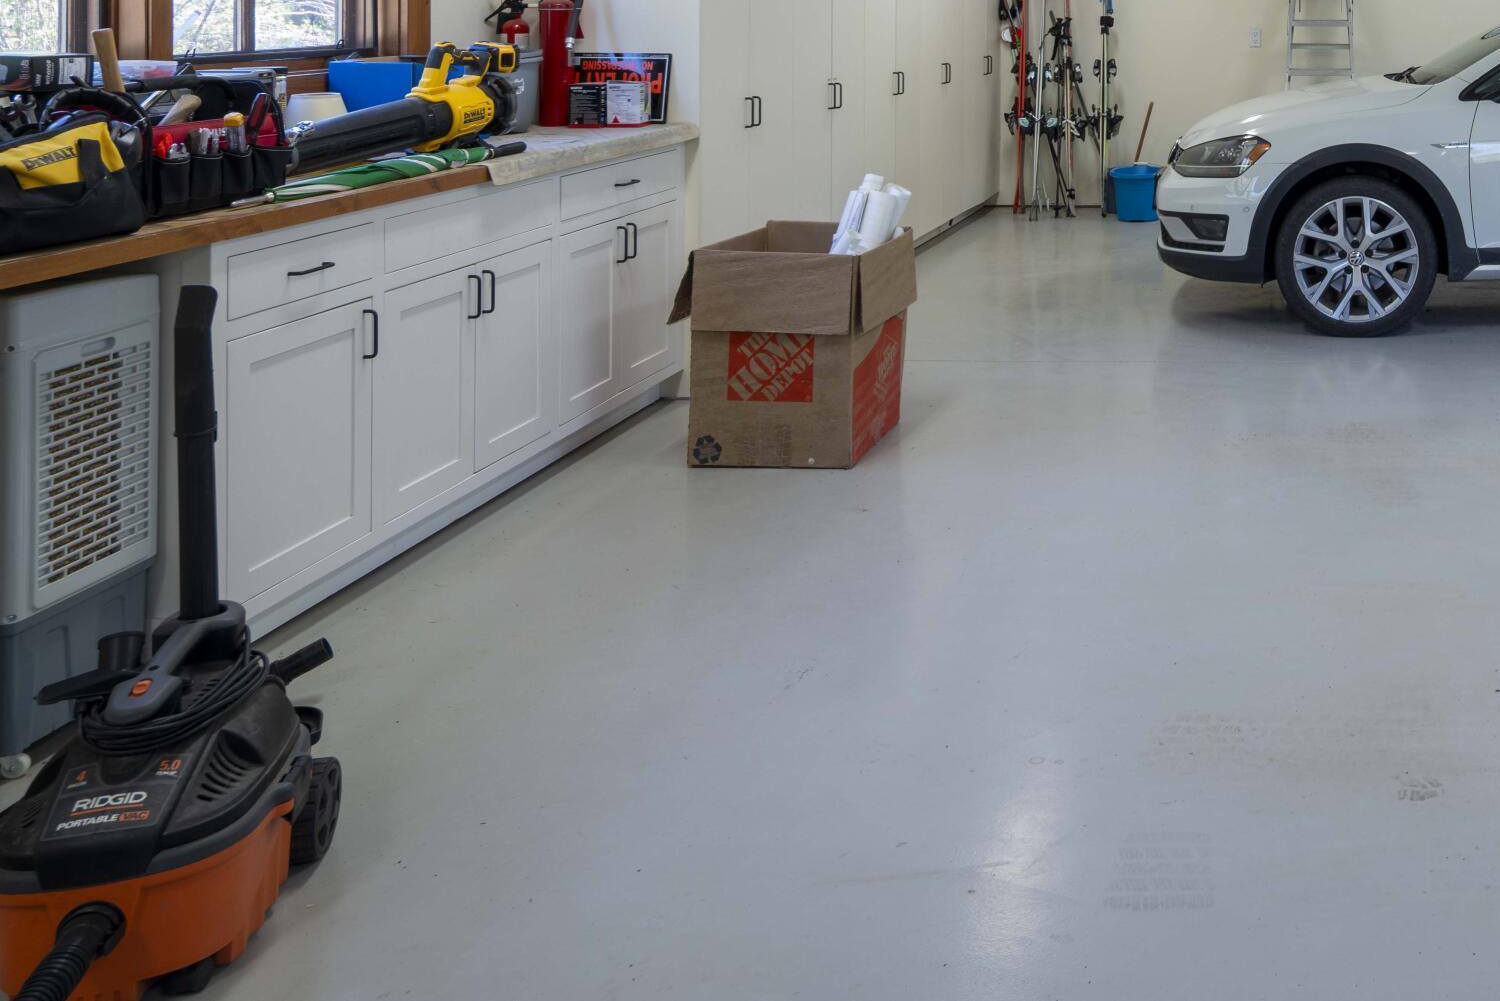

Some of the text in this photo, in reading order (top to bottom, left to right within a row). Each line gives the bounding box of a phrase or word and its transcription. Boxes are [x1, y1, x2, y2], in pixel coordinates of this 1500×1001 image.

[760, 348, 813, 401] DEPOT
[159, 759, 181, 771] 5.0
[72, 791, 148, 812] RIDGID
[56, 813, 122, 832] PORTABLE
